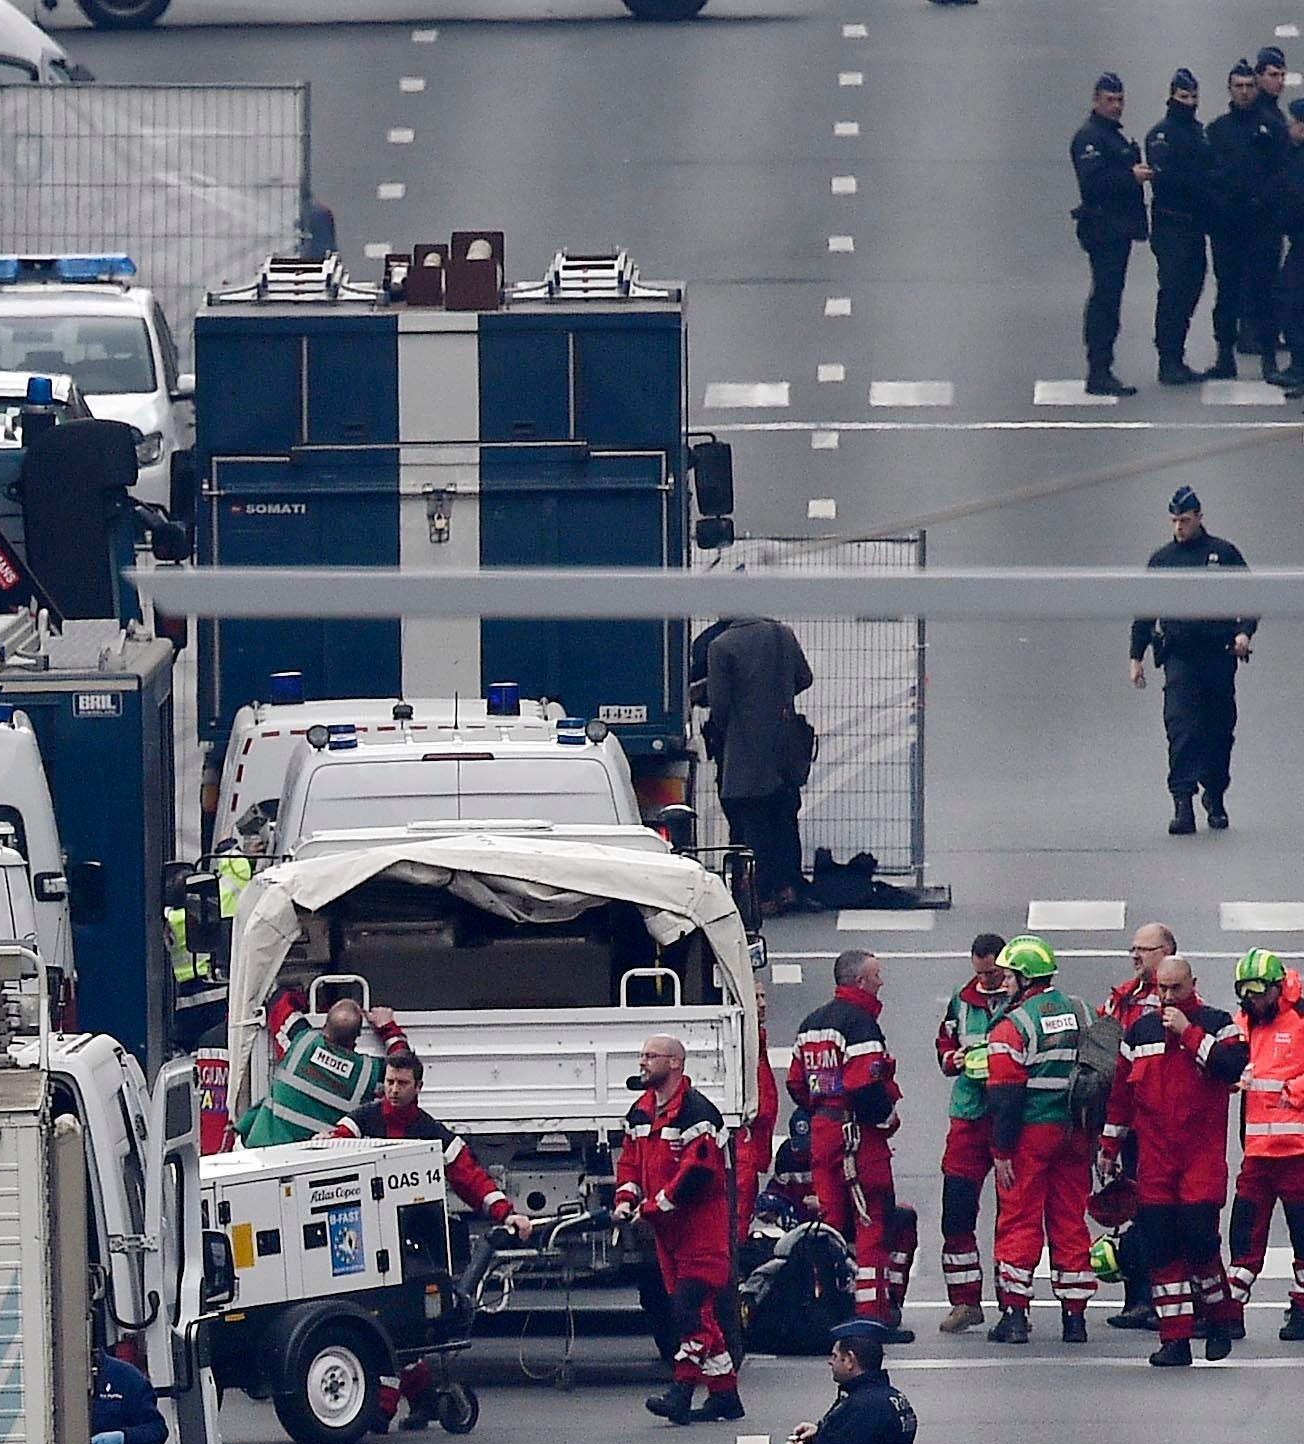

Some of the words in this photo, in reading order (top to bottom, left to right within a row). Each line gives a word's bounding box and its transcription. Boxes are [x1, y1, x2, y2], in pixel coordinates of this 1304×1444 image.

[245, 503, 307, 515] SOMATI
[78, 694, 116, 710] BRIL
[1045, 1016, 1074, 1030] MEDIC
[316, 1051, 349, 1074] MEDIC
[387, 1171, 420, 1190] QAS
[425, 1168, 442, 1185] 14
[310, 1189, 335, 1204] Atlas
[335, 1186, 361, 1200] Copco
